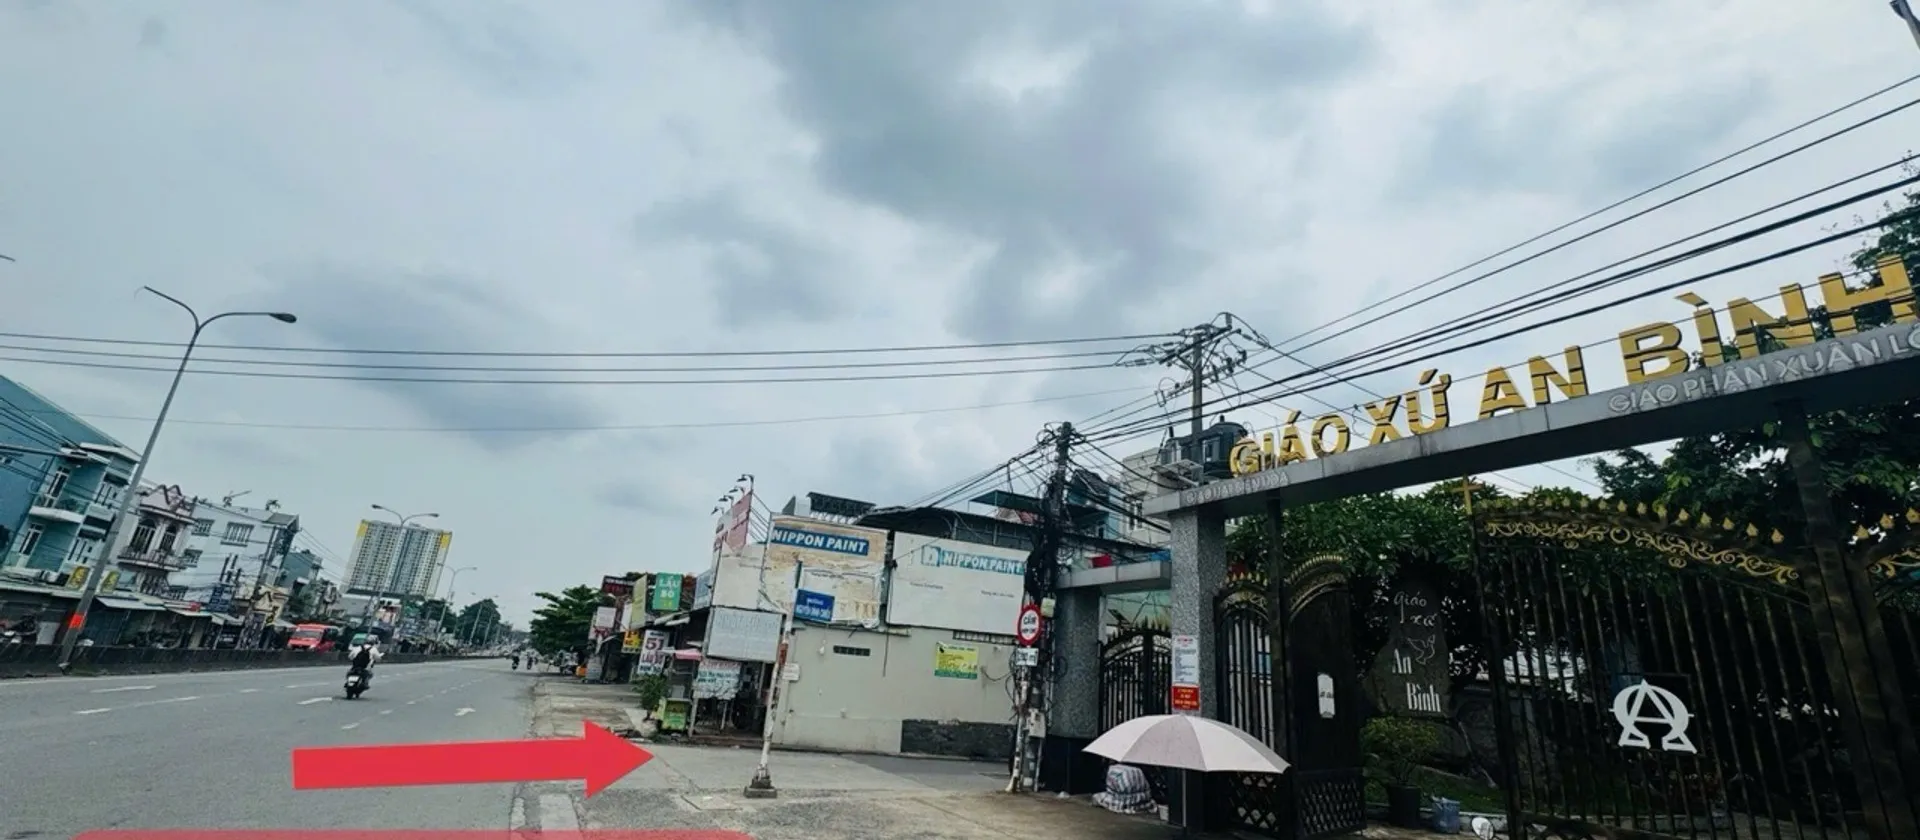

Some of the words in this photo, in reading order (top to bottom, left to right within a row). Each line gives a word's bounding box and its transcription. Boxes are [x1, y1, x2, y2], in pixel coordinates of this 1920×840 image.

[1229, 408, 1351, 477] GIÁO
[1365, 368, 1452, 446] XỨ
[1477, 345, 1589, 420] AN
[1618, 254, 1918, 385] BÌNH
[1608, 383, 1679, 413] GIÁO
[1682, 362, 1769, 399] PHẬN
[1776, 338, 1882, 381] XUÂN
[772, 529, 825, 548] NIPPON
[826, 538, 868, 553] PAINT
[943, 550, 989, 570] NIPPON
[989, 558, 1026, 574] PAINT
[1392, 648, 1412, 674] An
[1406, 682, 1441, 712] Bình
